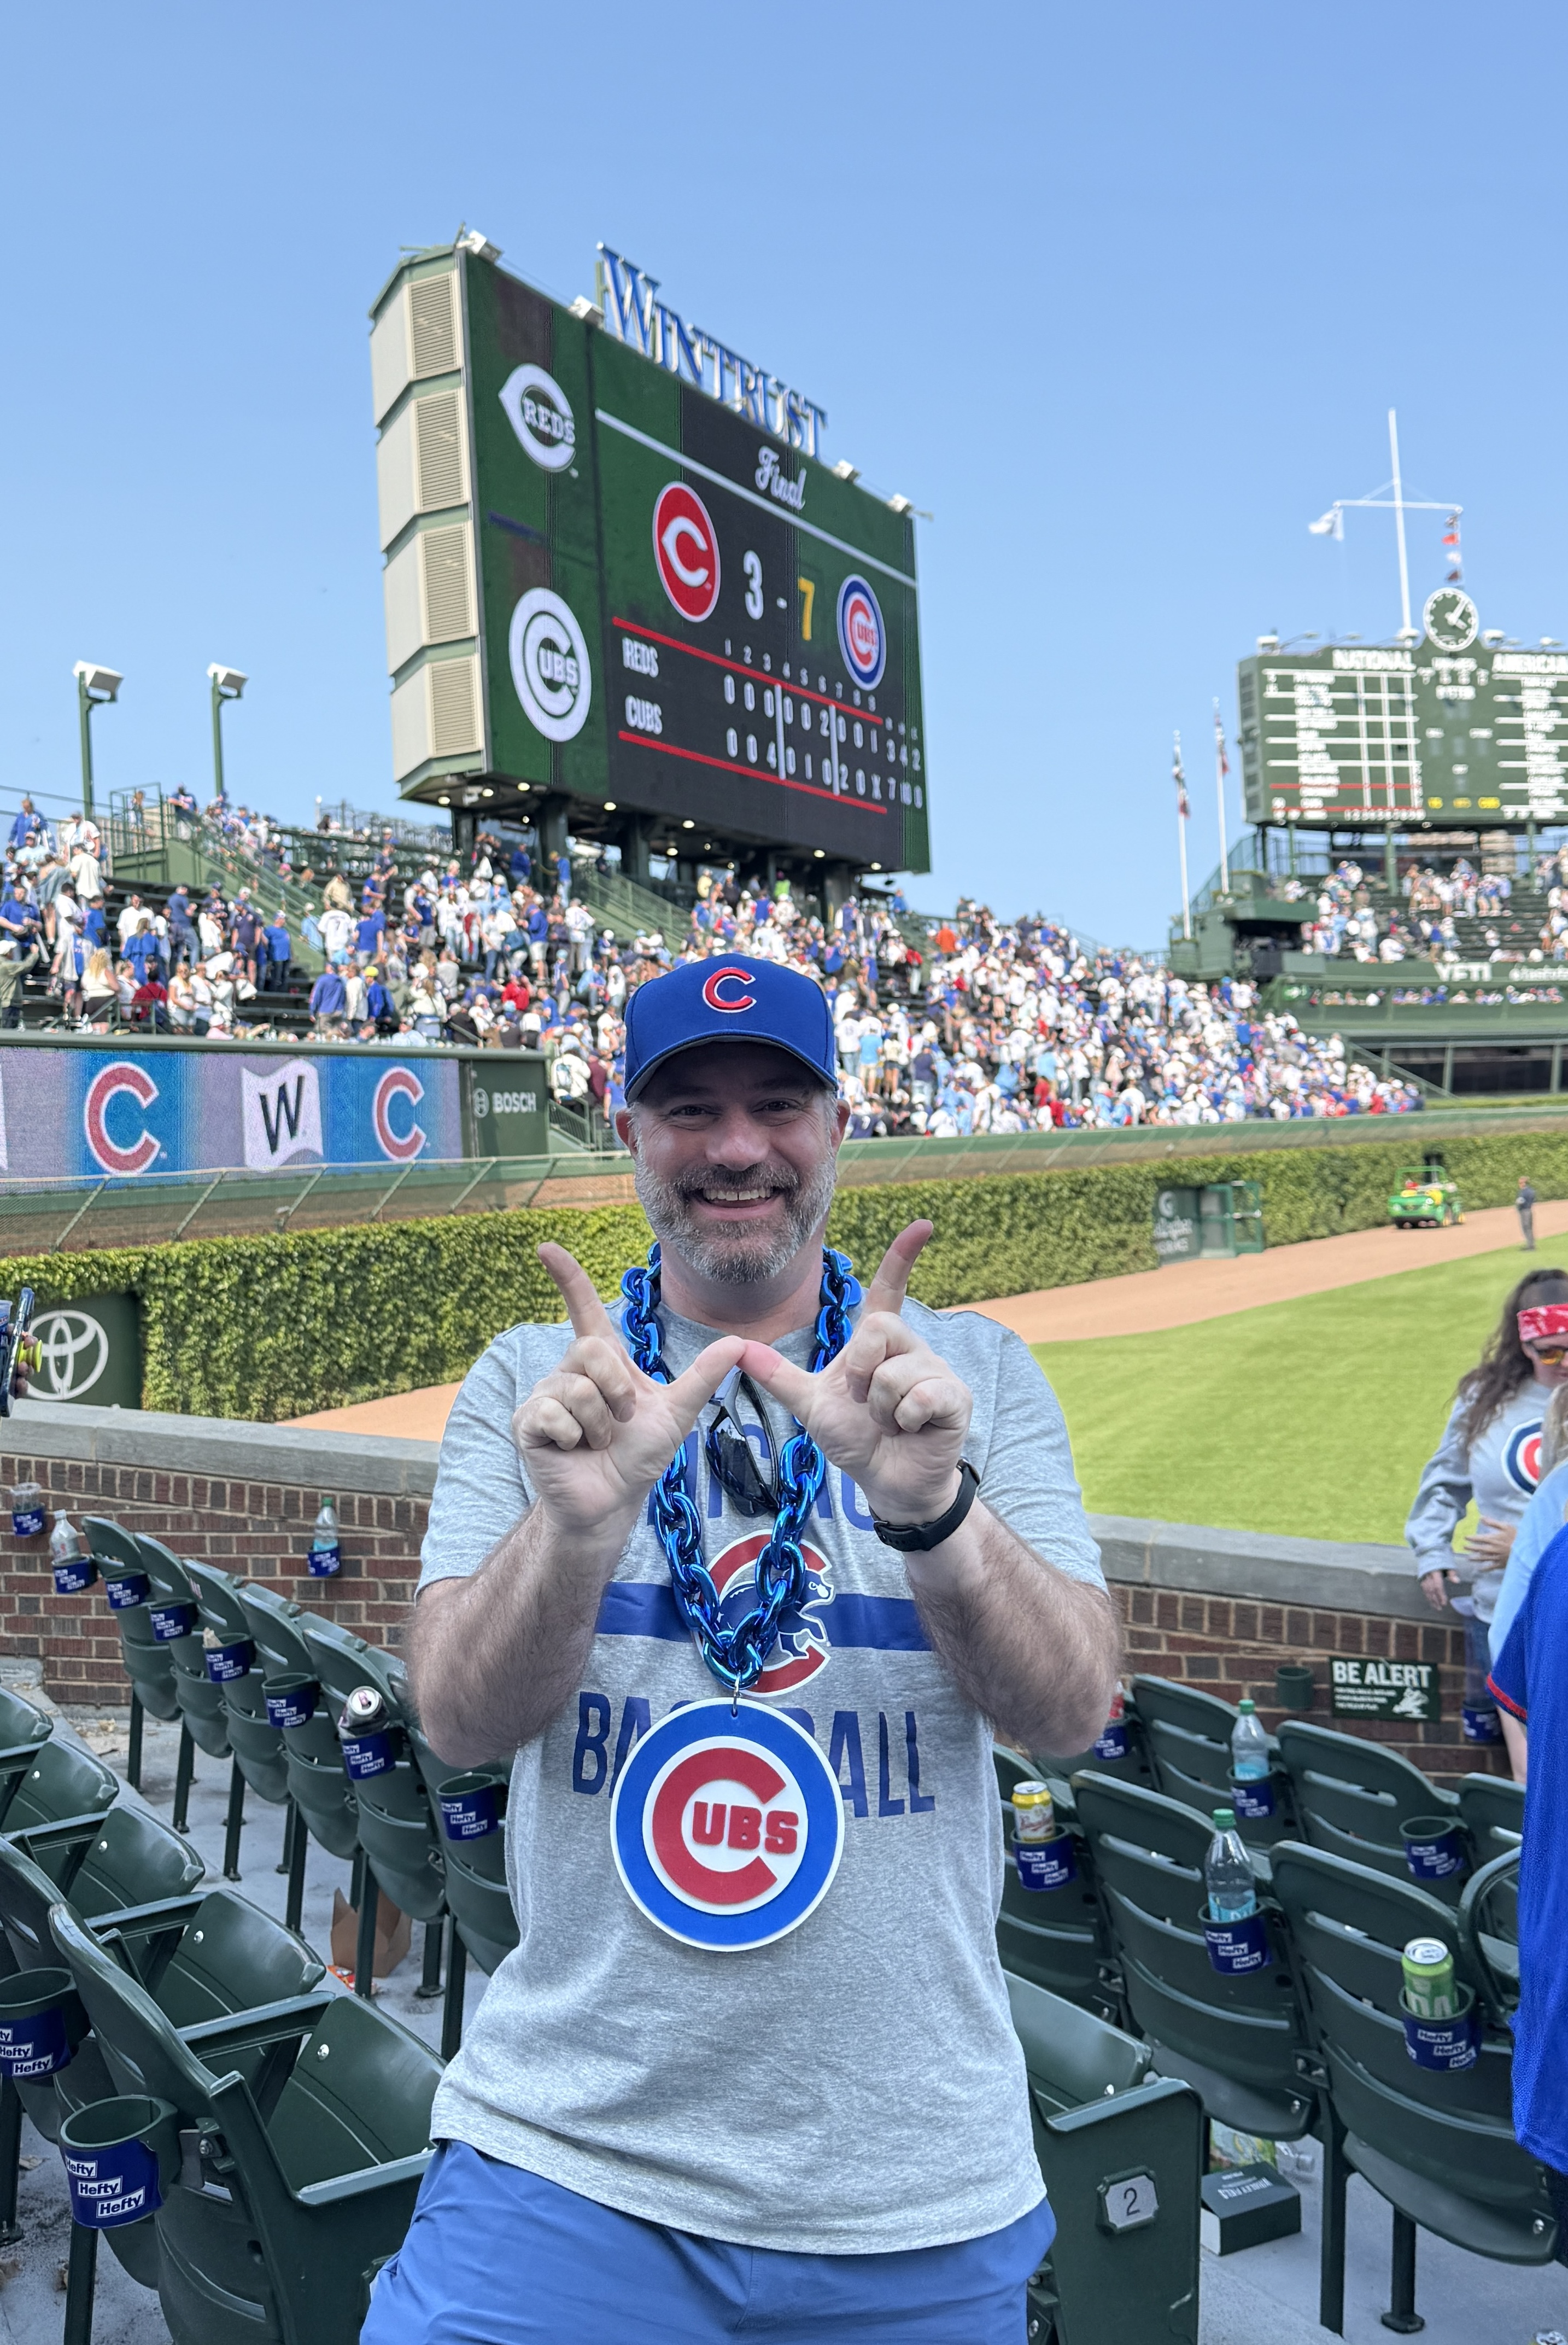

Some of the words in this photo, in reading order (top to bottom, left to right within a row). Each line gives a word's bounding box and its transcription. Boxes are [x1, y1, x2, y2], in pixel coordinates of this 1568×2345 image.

[598, 242, 828, 462] WINTRUST
[523, 396, 576, 445] REDS
[755, 445, 807, 510] Final
[662, 516, 709, 588] C
[744, 550, 764, 620] 3
[798, 577, 815, 640] 7
[724, 638, 732, 656] 1
[743, 645, 752, 664] 2
[1332, 649, 1417, 670] NATIONAL
[622, 637, 659, 678] REDS
[723, 674, 735, 704] 0
[744, 681, 755, 711] 0
[763, 689, 775, 718] 0
[783, 696, 793, 725] 0
[800, 702, 811, 731] 0
[820, 709, 830, 737] 2
[836, 715, 847, 743] 0
[853, 721, 863, 749] 0
[870, 728, 878, 754] 1
[886, 739, 896, 763] 3
[911, 748, 921, 772] 2
[625, 695, 662, 734] CUBS
[726, 727, 738, 757] 0
[746, 733, 758, 763] 0
[767, 741, 777, 769] 4
[785, 746, 796, 775] 0
[805, 752, 812, 780] 1
[822, 757, 832, 786] 0
[839, 763, 849, 791] 2
[855, 768, 866, 796] 0
[887, 776, 896, 801] 7
[914, 785, 923, 809] 0
[703, 967, 757, 1013] C
[1434, 962, 1492, 982] YETI
[84, 1060, 161, 1176] C
[259, 1075, 305, 1154] W
[372, 1066, 428, 1161] C
[492, 1092, 537, 1114] BOSCH
[1332, 1660, 1362, 1685] BE
[1364, 1662, 1432, 1688] ALERT
[15, 2058, 50, 2073] Hefty
[80, 2183, 119, 2195] Hefty
[100, 2194, 142, 2214] Hefty
[1124, 2188, 1140, 2216] 2
